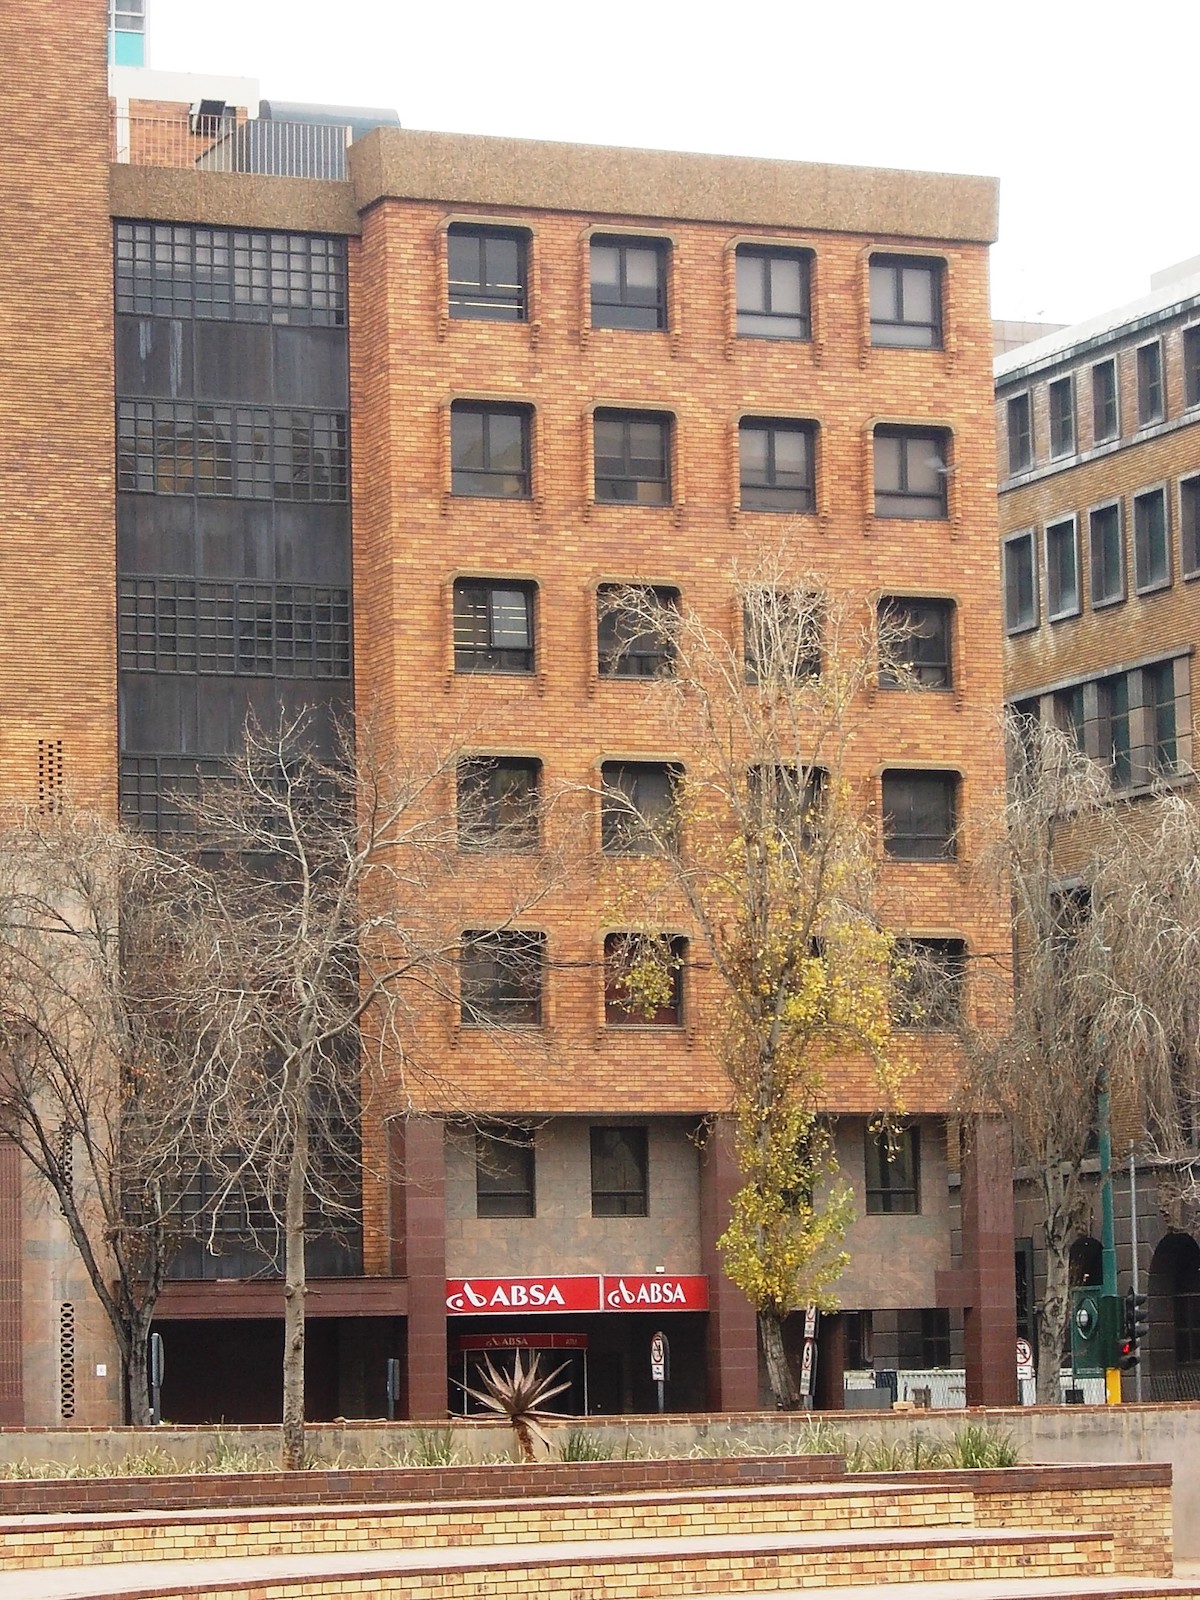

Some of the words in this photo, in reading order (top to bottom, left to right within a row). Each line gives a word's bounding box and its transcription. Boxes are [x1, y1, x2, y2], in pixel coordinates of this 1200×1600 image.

[490, 1284, 565, 1306] ABSA
[636, 1283, 687, 1303] ABSA
[501, 1337, 529, 1346] ABSA
